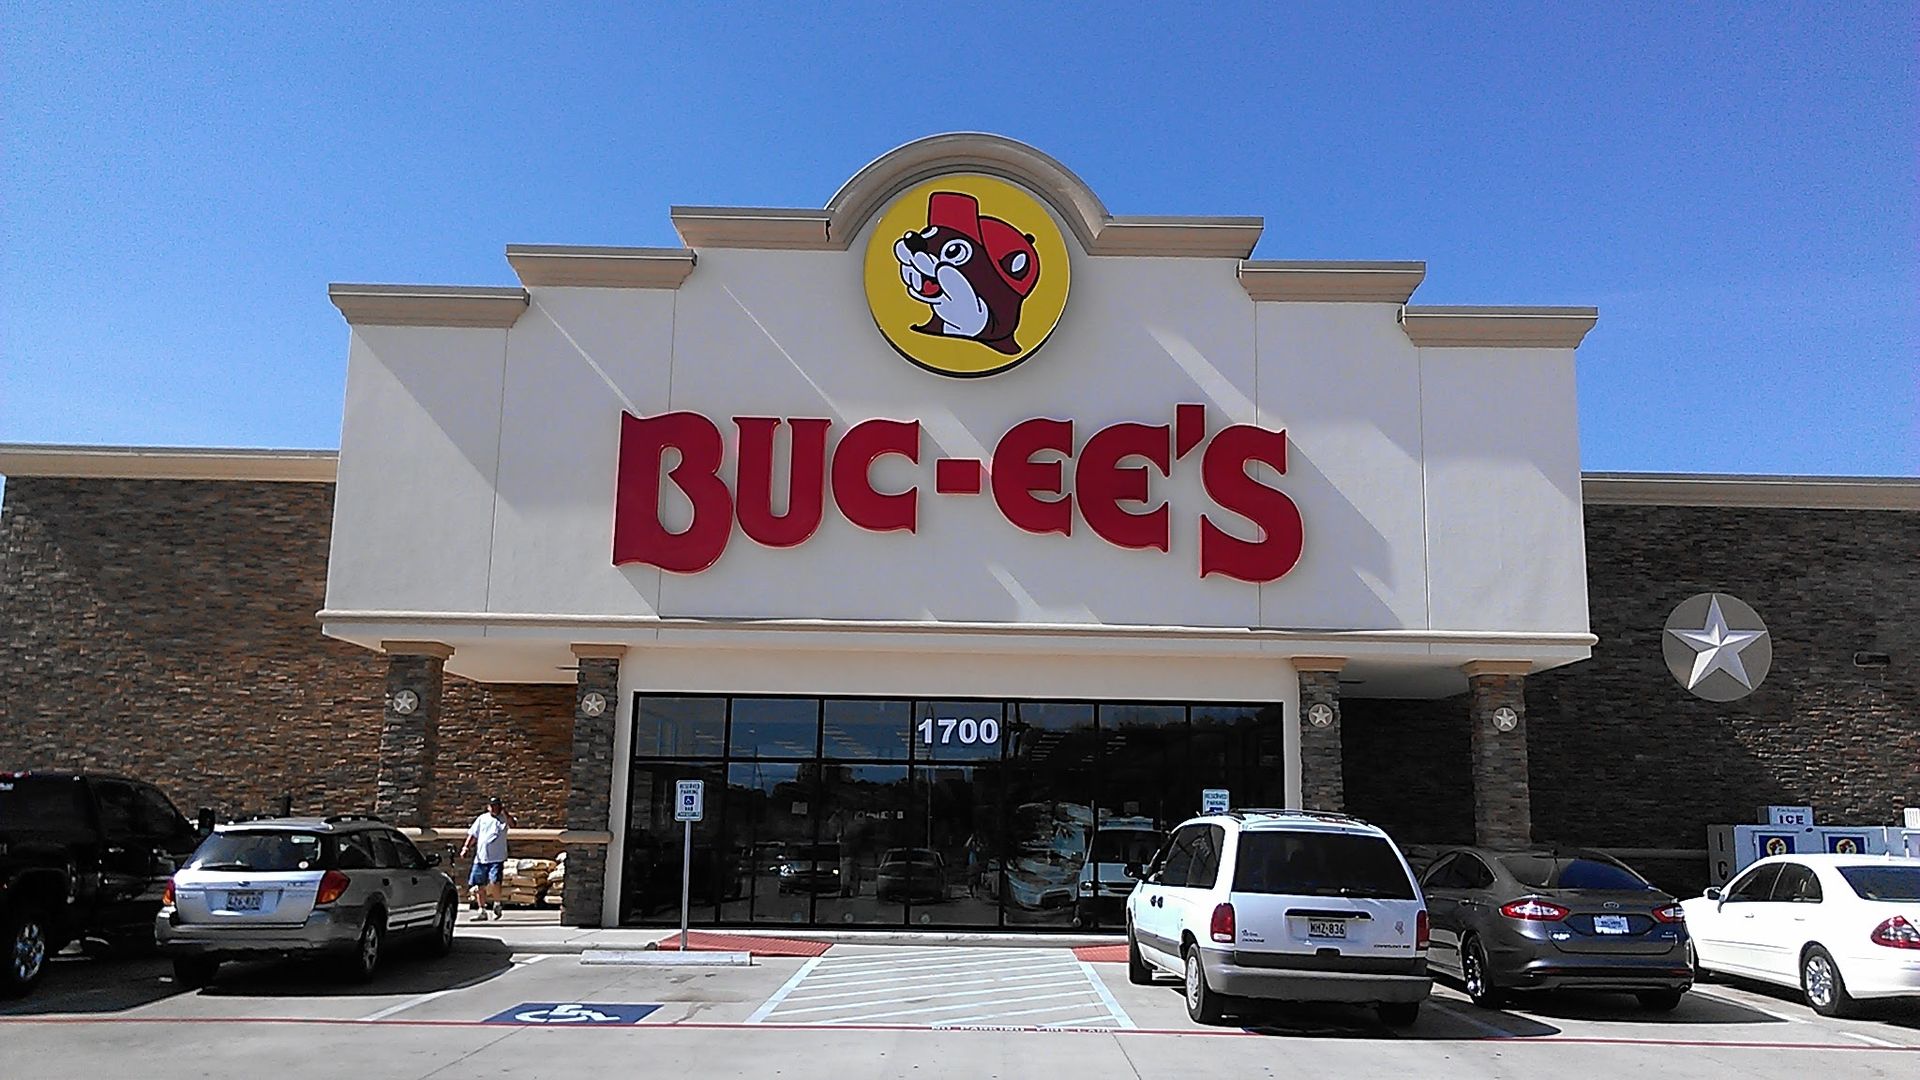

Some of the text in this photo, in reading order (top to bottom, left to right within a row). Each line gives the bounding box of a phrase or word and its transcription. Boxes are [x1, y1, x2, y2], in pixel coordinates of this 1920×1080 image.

[612, 403, 1304, 583] BUC-EE'S
[918, 718, 1000, 744] 1700
[1779, 815, 1804, 825] ICE
